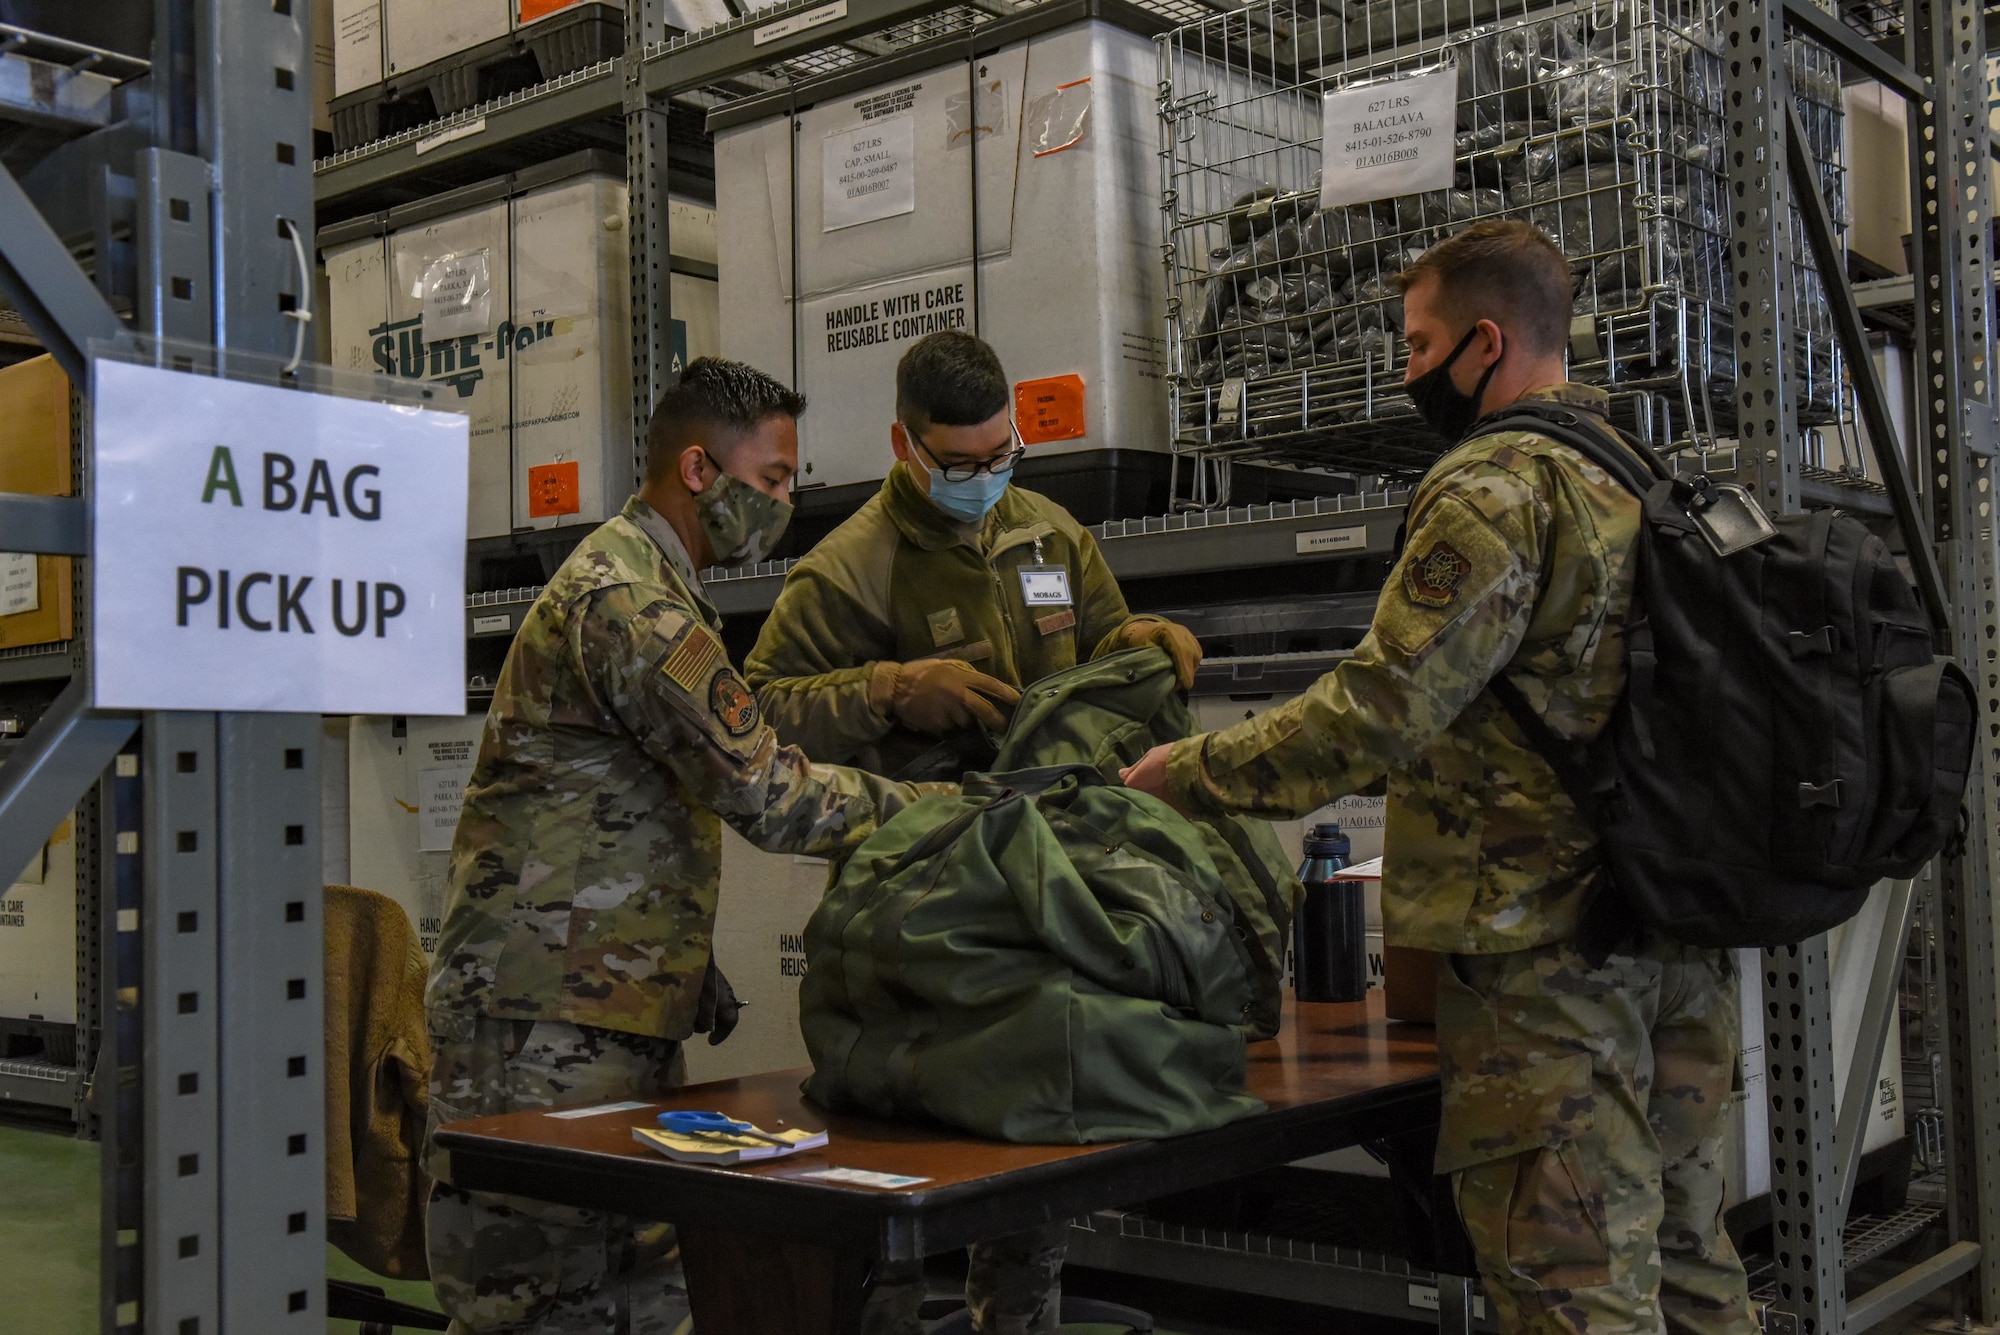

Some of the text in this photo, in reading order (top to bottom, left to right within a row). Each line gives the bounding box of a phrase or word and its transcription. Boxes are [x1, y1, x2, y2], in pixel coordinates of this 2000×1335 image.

[872, 92, 891, 103] INDICATE
[892, 87, 910, 97] LOCKING
[1368, 96, 1410, 113] 627 LRS
[860, 106, 872, 115] PUSH
[873, 100, 889, 110] INWARD
[863, 113, 873, 121] PULL
[874, 107, 894, 118] OUTWARD
[1353, 111, 1424, 134] BALACLAVA
[853, 138, 882, 153] 627 LRS
[1345, 127, 1432, 153] 8415-01-526-8790
[845, 150, 891, 169] CAP, SMALL
[1355, 147, 1419, 169] 01A016B008
[839, 163, 898, 185] 8415-00-269-0487
[847, 179, 890, 198] 01A016B007
[456, 268, 467, 277] LRS
[826, 284, 964, 330] HANDLE WITH CARE
[827, 308, 965, 353] REUSABLE CONTAINER
[201, 445, 382, 522] A BAG
[177, 566, 407, 639] PICK UP
[439, 781, 447, 789] 627
[434, 793, 455, 801] PARKA,
[8, 900, 24, 912] CARE
[0, 915, 24, 927] NTAINER
[781, 934, 806, 953] HAN
[781, 957, 806, 976] REUS
